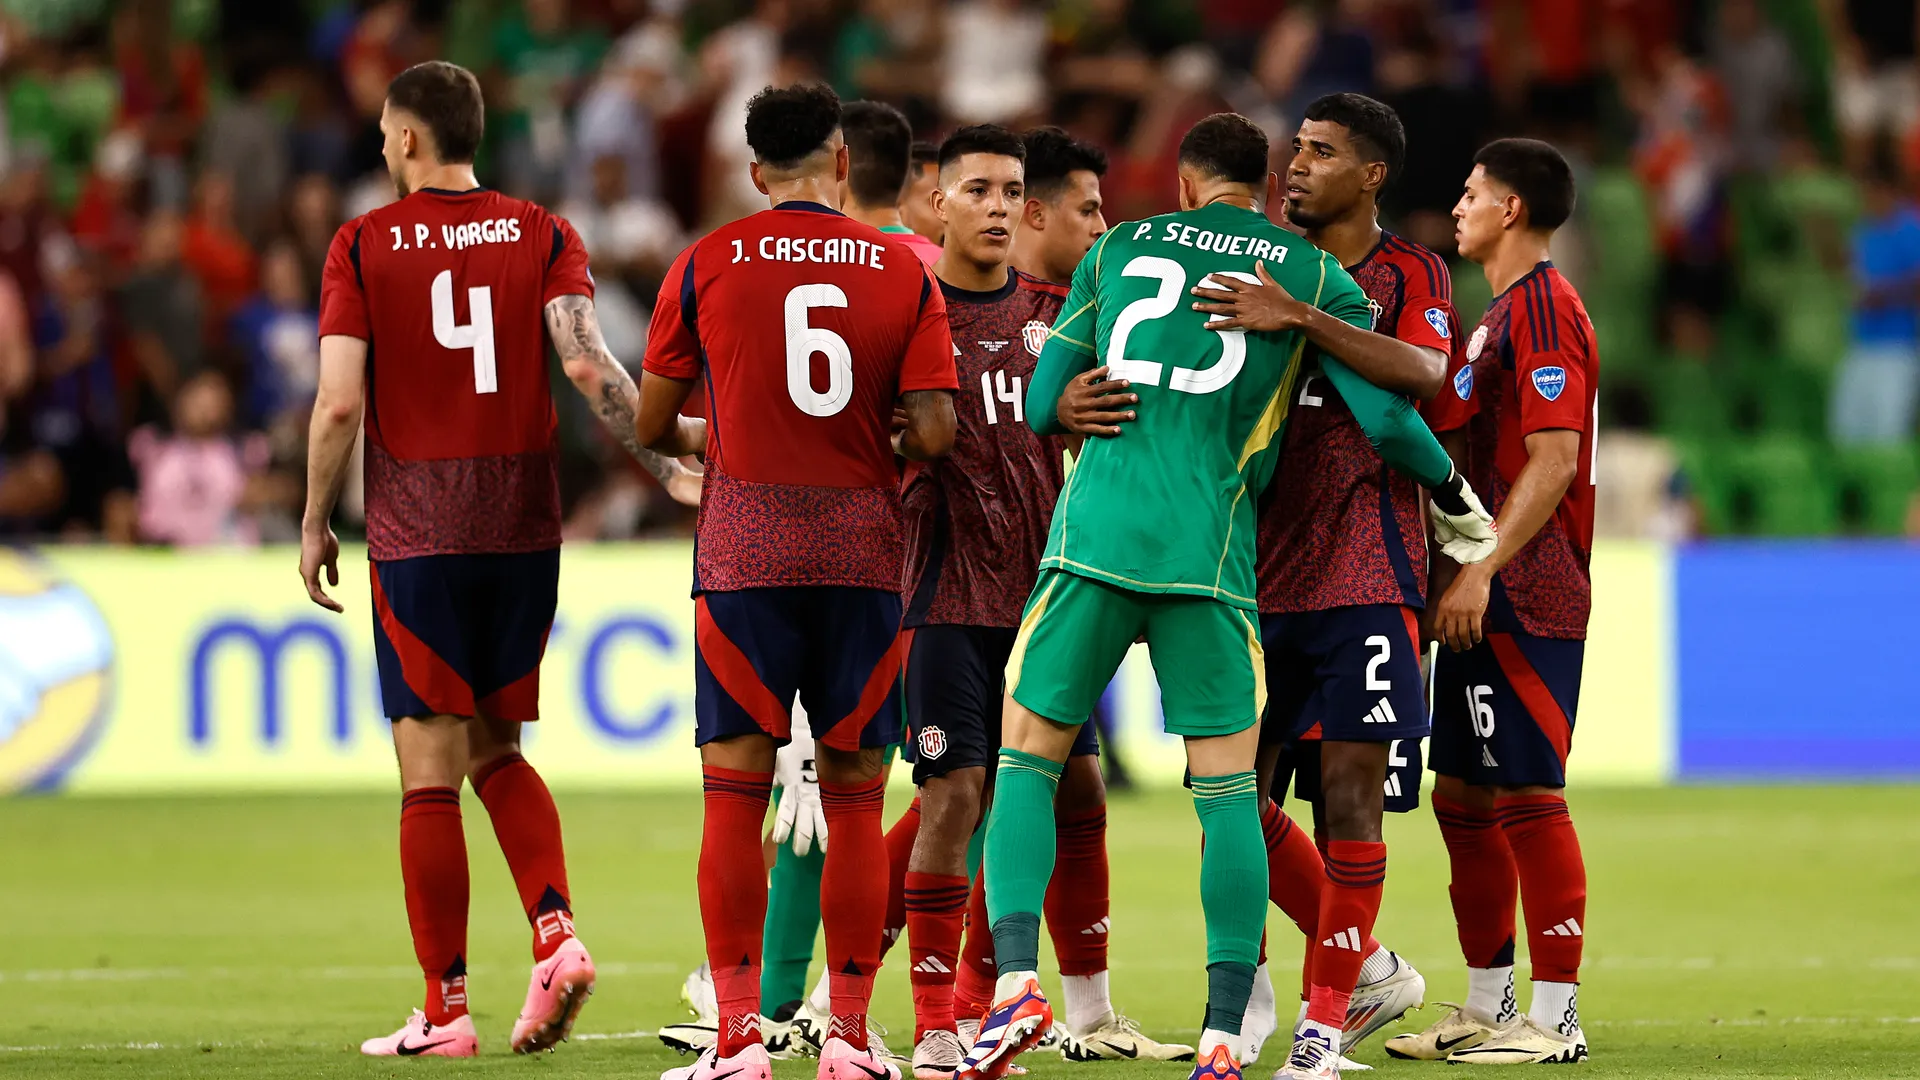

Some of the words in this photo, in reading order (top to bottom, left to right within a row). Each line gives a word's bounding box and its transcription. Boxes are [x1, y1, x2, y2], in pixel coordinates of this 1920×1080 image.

[390, 225, 410, 251] J.
[415, 223, 436, 249] P.
[442, 218, 521, 250] VARGAS
[731, 239, 751, 264] J.
[759, 236, 886, 270] CASCANTE
[1132, 222, 1152, 241] P.
[1162, 222, 1289, 264] SEQUEIRA
[431, 269, 498, 394] 4
[784, 283, 853, 417] 6
[981, 369, 1023, 425] 14
[1537, 374, 1562, 383] VIBRA
[1364, 635, 1391, 691] 2
[1465, 684, 1495, 738] 16
[923, 733, 941, 754] CR
